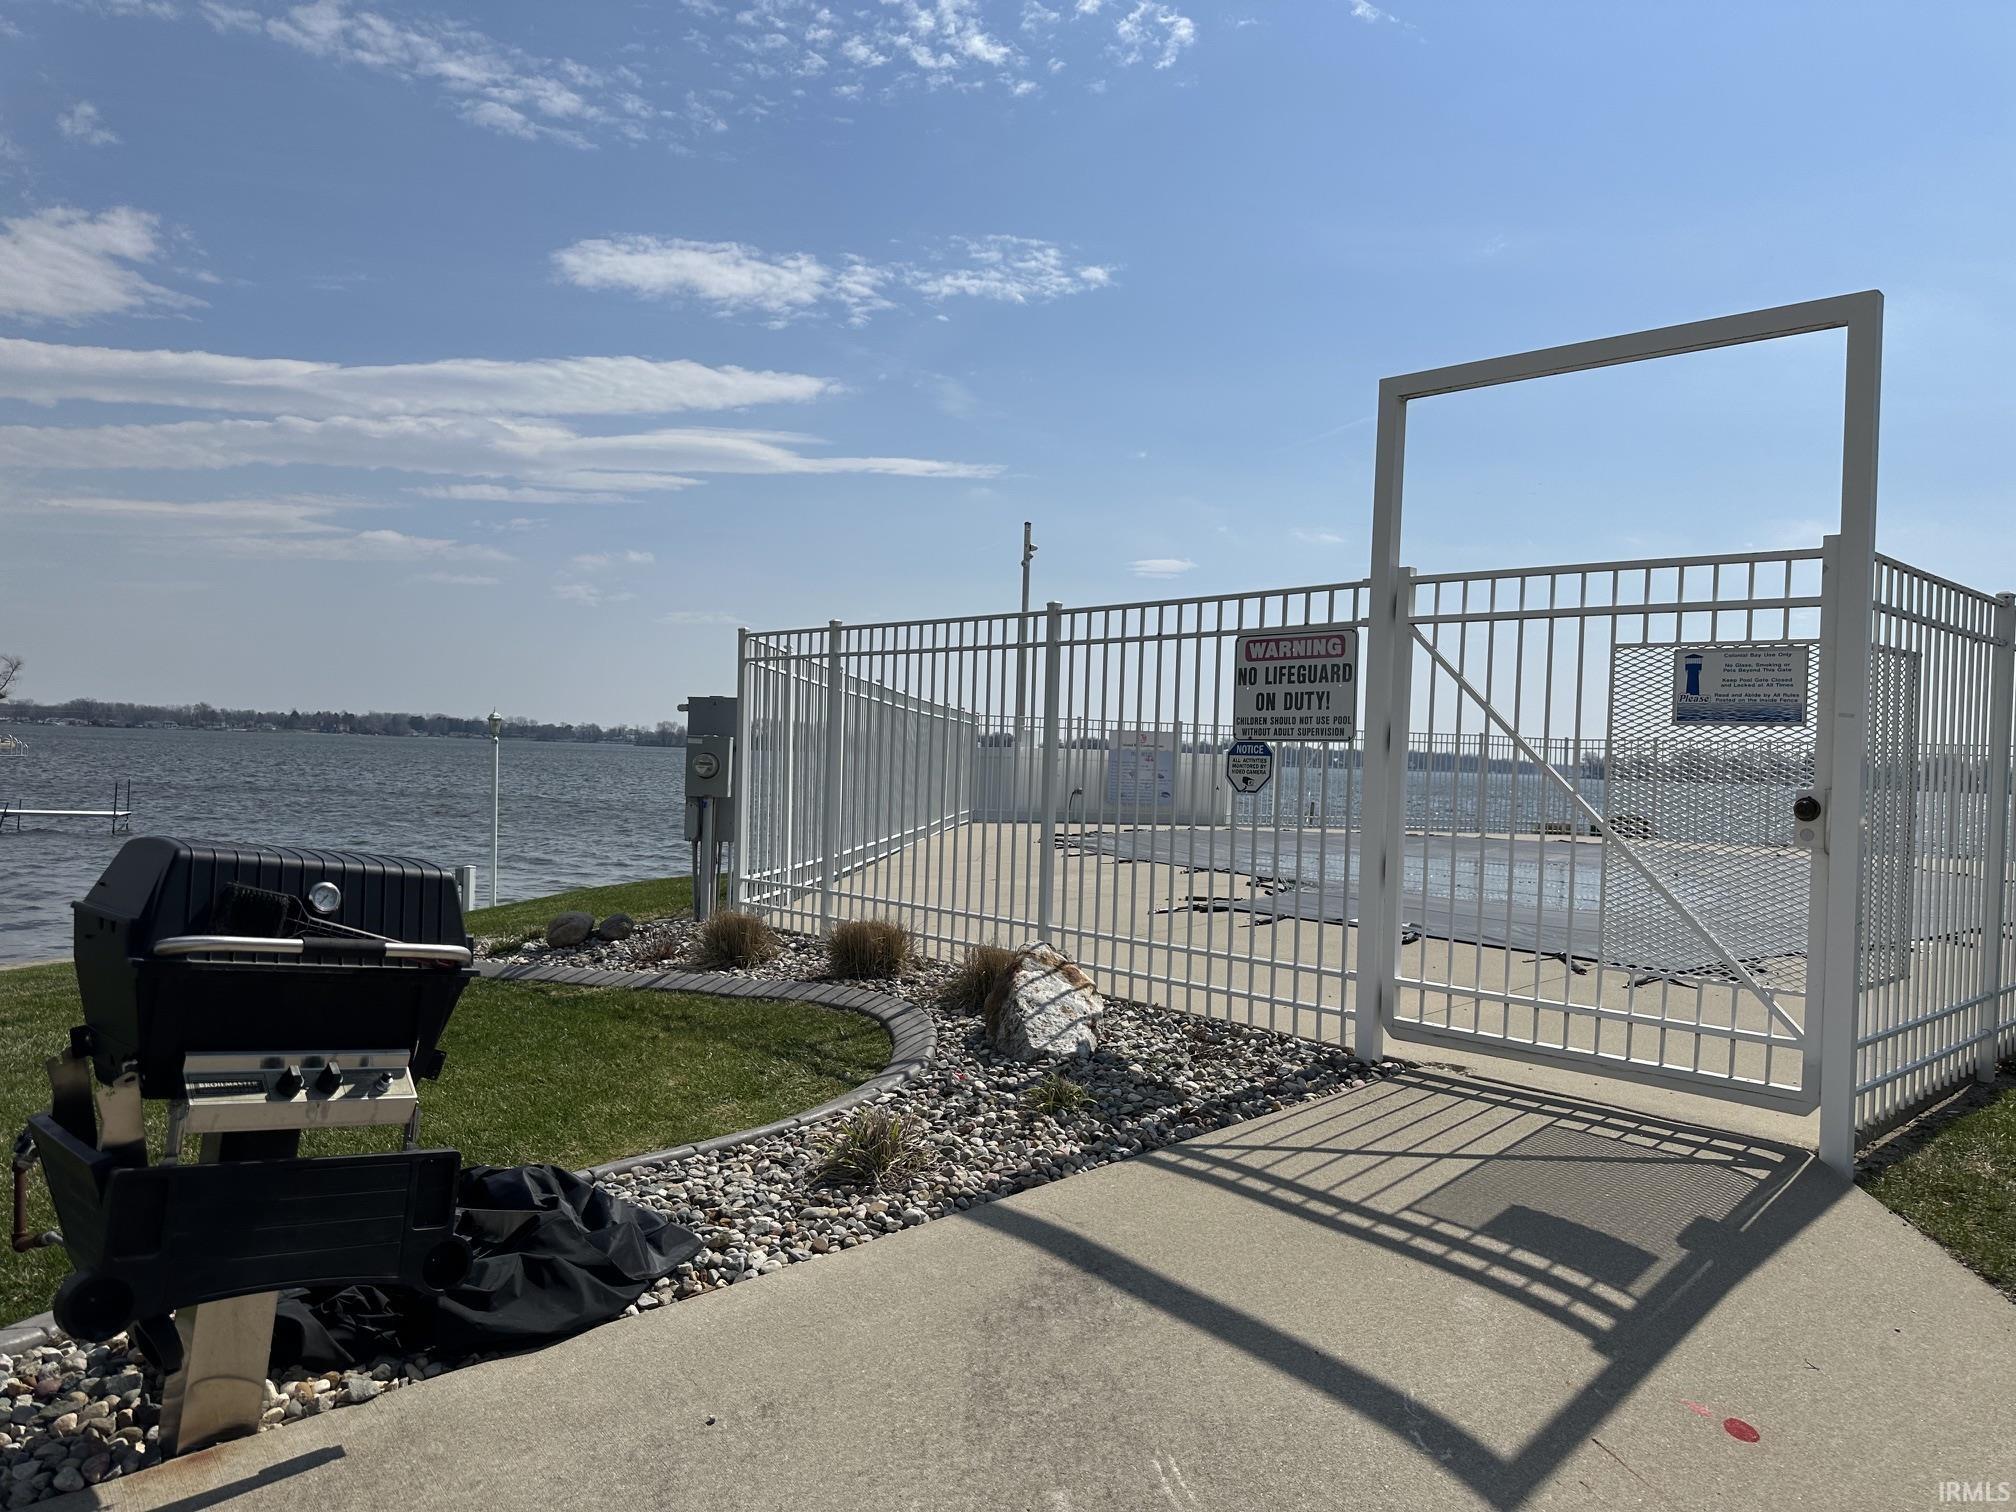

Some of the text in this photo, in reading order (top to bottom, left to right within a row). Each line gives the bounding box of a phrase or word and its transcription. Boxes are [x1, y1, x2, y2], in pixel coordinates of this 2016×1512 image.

[1249, 638, 1342, 658] WARNING
[1238, 663, 1352, 686] NO LIFEGUARD
[1256, 691, 1330, 711] ON DUTY!
[1680, 694, 1710, 703] Please
[1236, 716, 1352, 726] CHILDREN SHOULD NOT USE POOL
[1242, 728, 1344, 736] WITHOUT ADULT SUPERVISION
[1236, 744, 1264, 754] NOTICE
